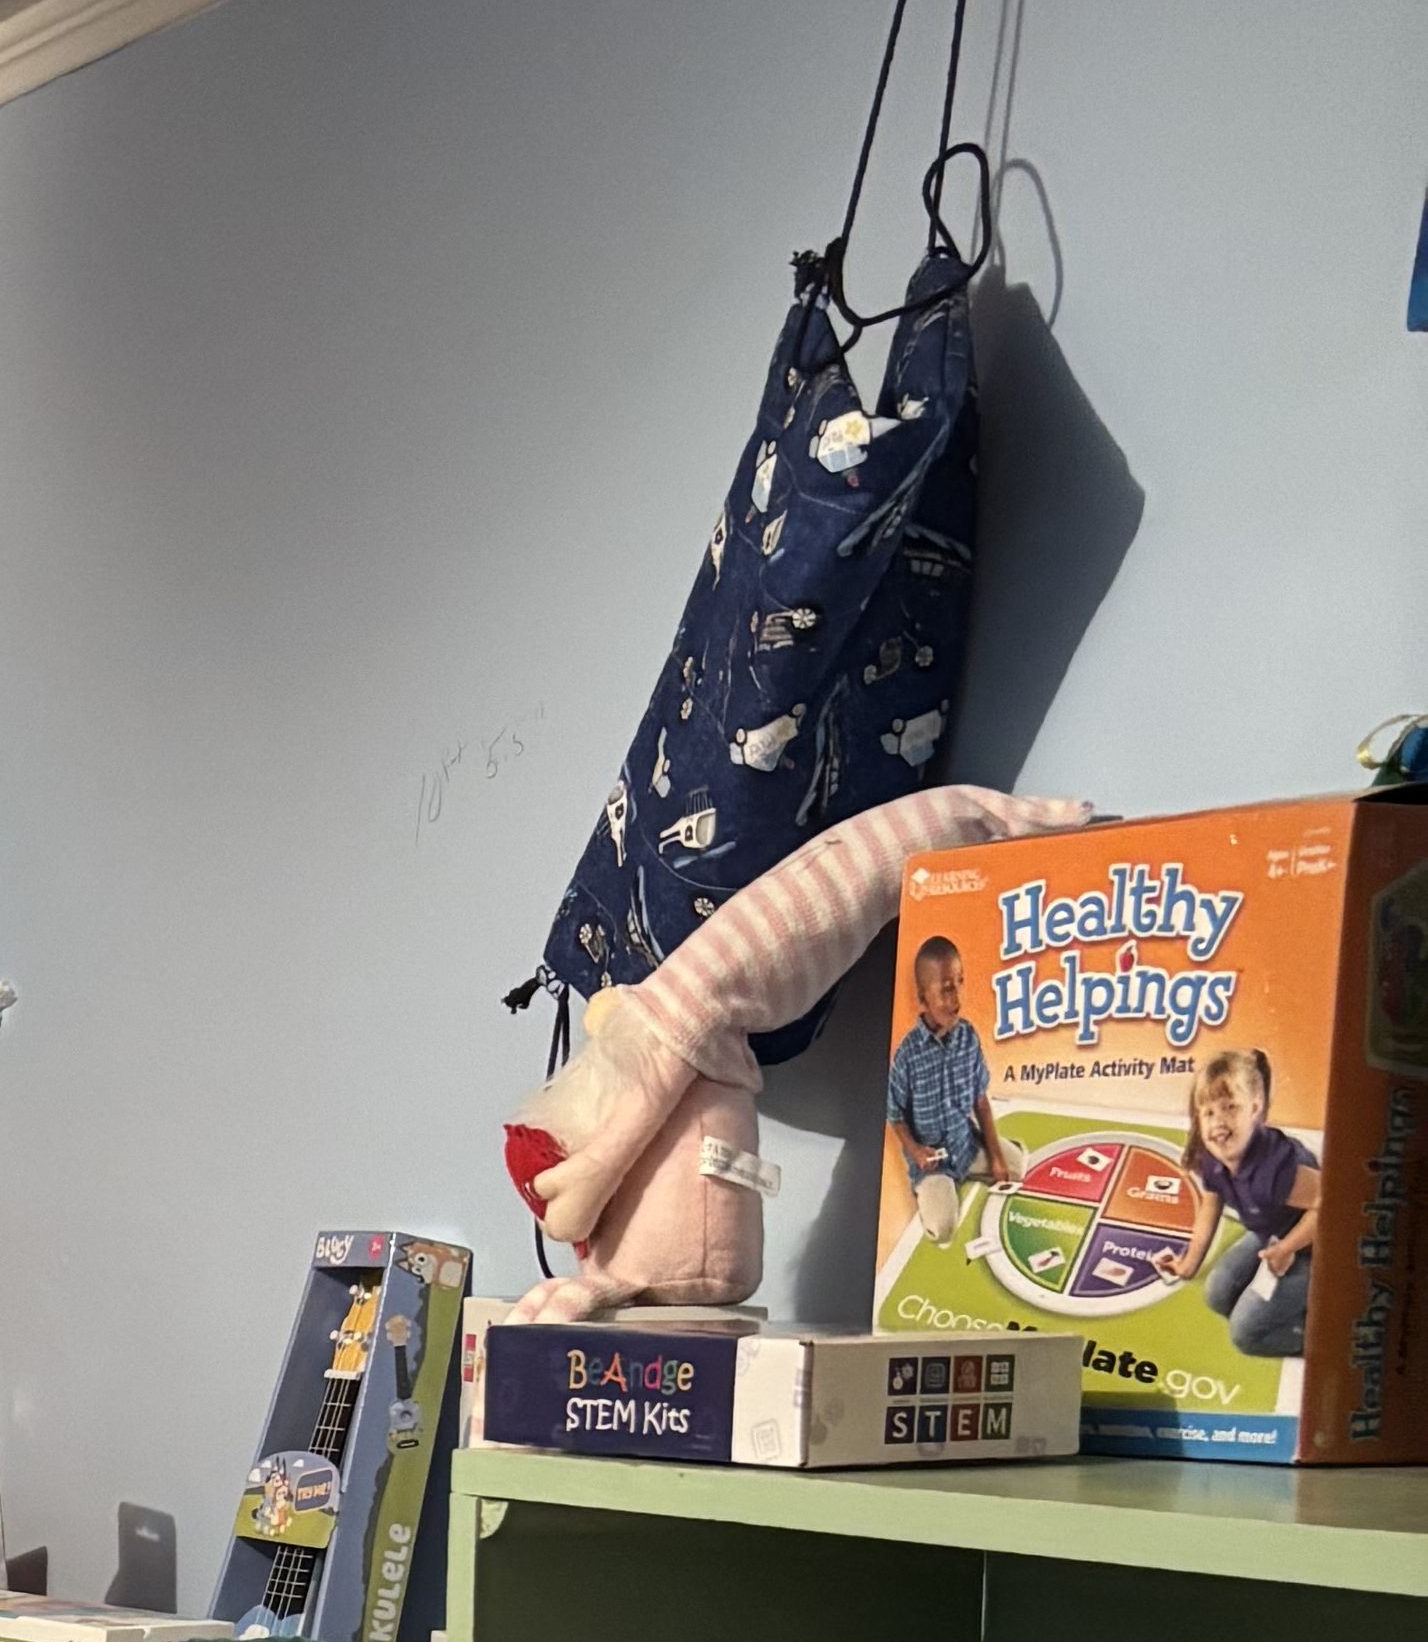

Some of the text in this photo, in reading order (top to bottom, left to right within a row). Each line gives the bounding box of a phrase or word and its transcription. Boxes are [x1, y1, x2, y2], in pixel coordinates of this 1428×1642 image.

[998, 863, 1244, 962] Healthy
[993, 947, 1238, 1048] Helpings
[1004, 1056, 1196, 1086] A MyPlate Activity Mat
[1048, 1166, 1092, 1184] Fruits
[1126, 1186, 1180, 1206] Grains
[567, 1348, 695, 1395] BeAndge
[565, 1398, 693, 1435] STEM Kits
[891, 1409, 1008, 1441] STEM
